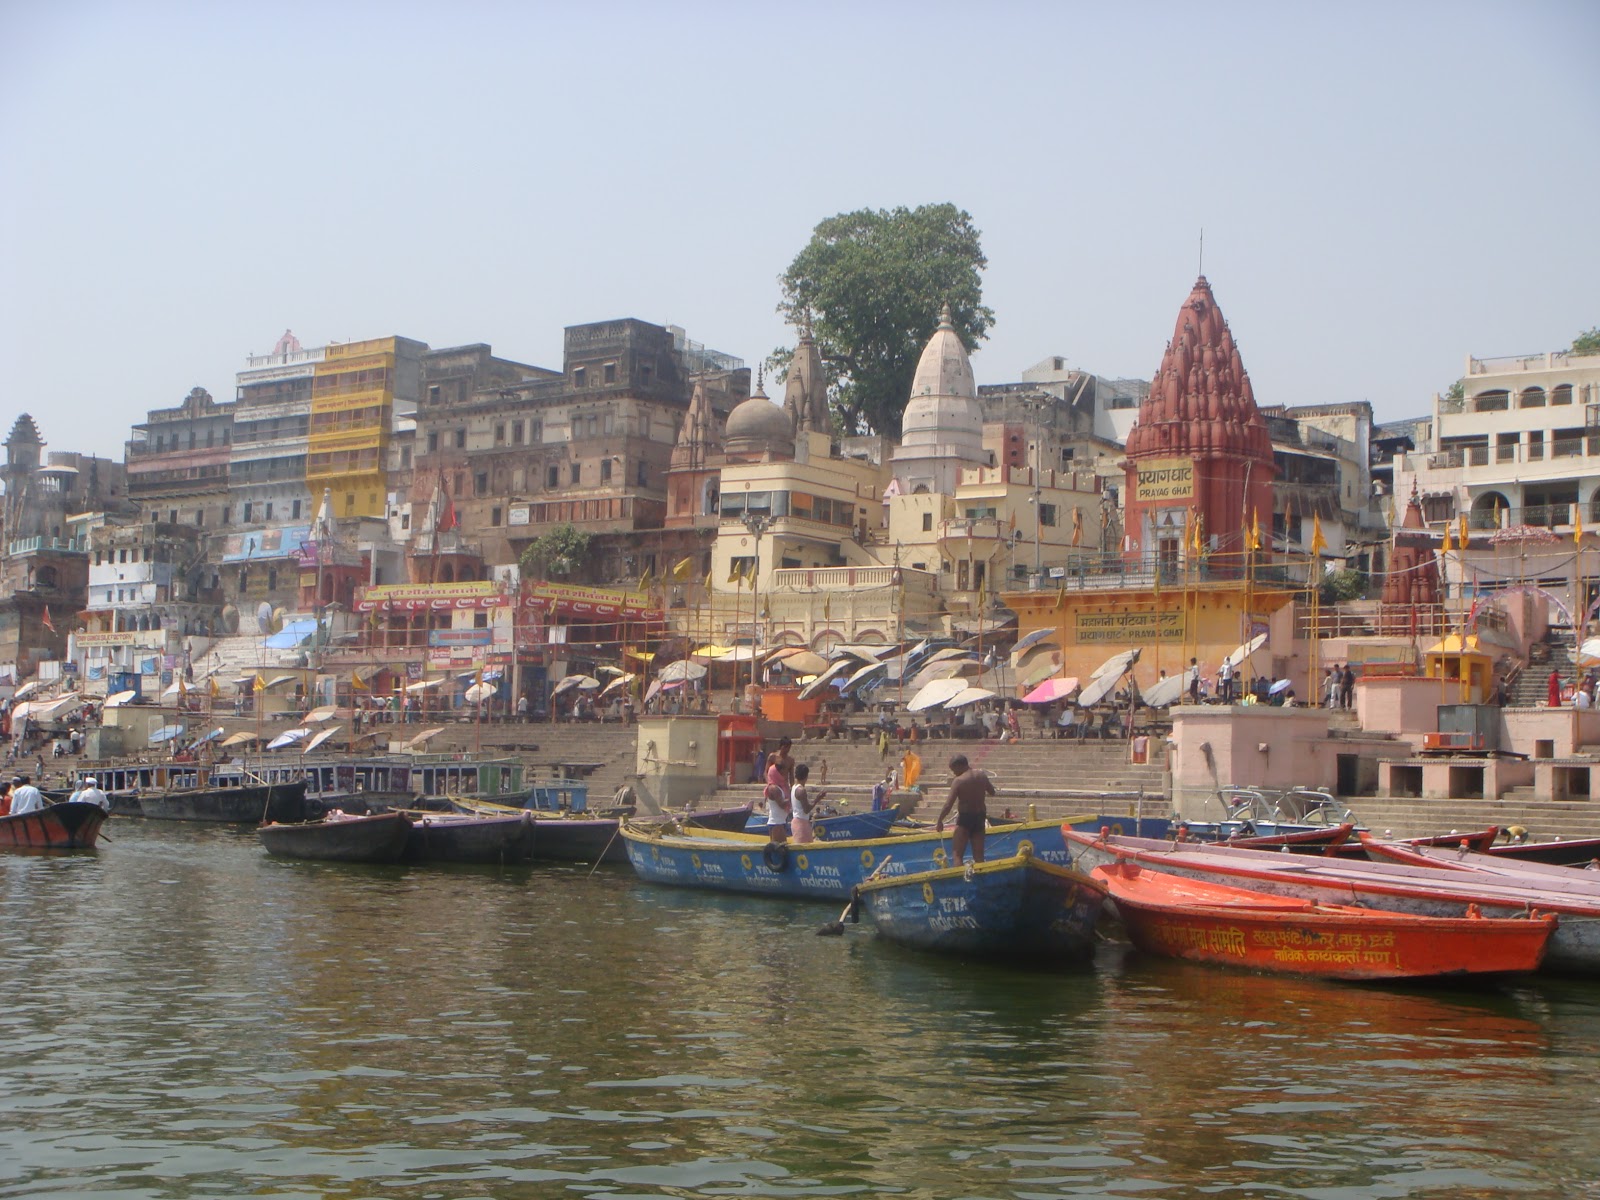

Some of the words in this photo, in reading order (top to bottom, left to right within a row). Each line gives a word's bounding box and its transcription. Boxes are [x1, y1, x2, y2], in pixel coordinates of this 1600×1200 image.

[1137, 469, 1171, 487] प्रयाग
[1171, 467, 1193, 482] घाट
[1139, 487, 1170, 498] PRAYAG
[1171, 486, 1193, 496] GHAT
[1163, 628, 1184, 637] GHAT
[830, 830, 853, 838] TATA
[814, 865, 841, 876] TATA
[800, 874, 843, 889] indicom
